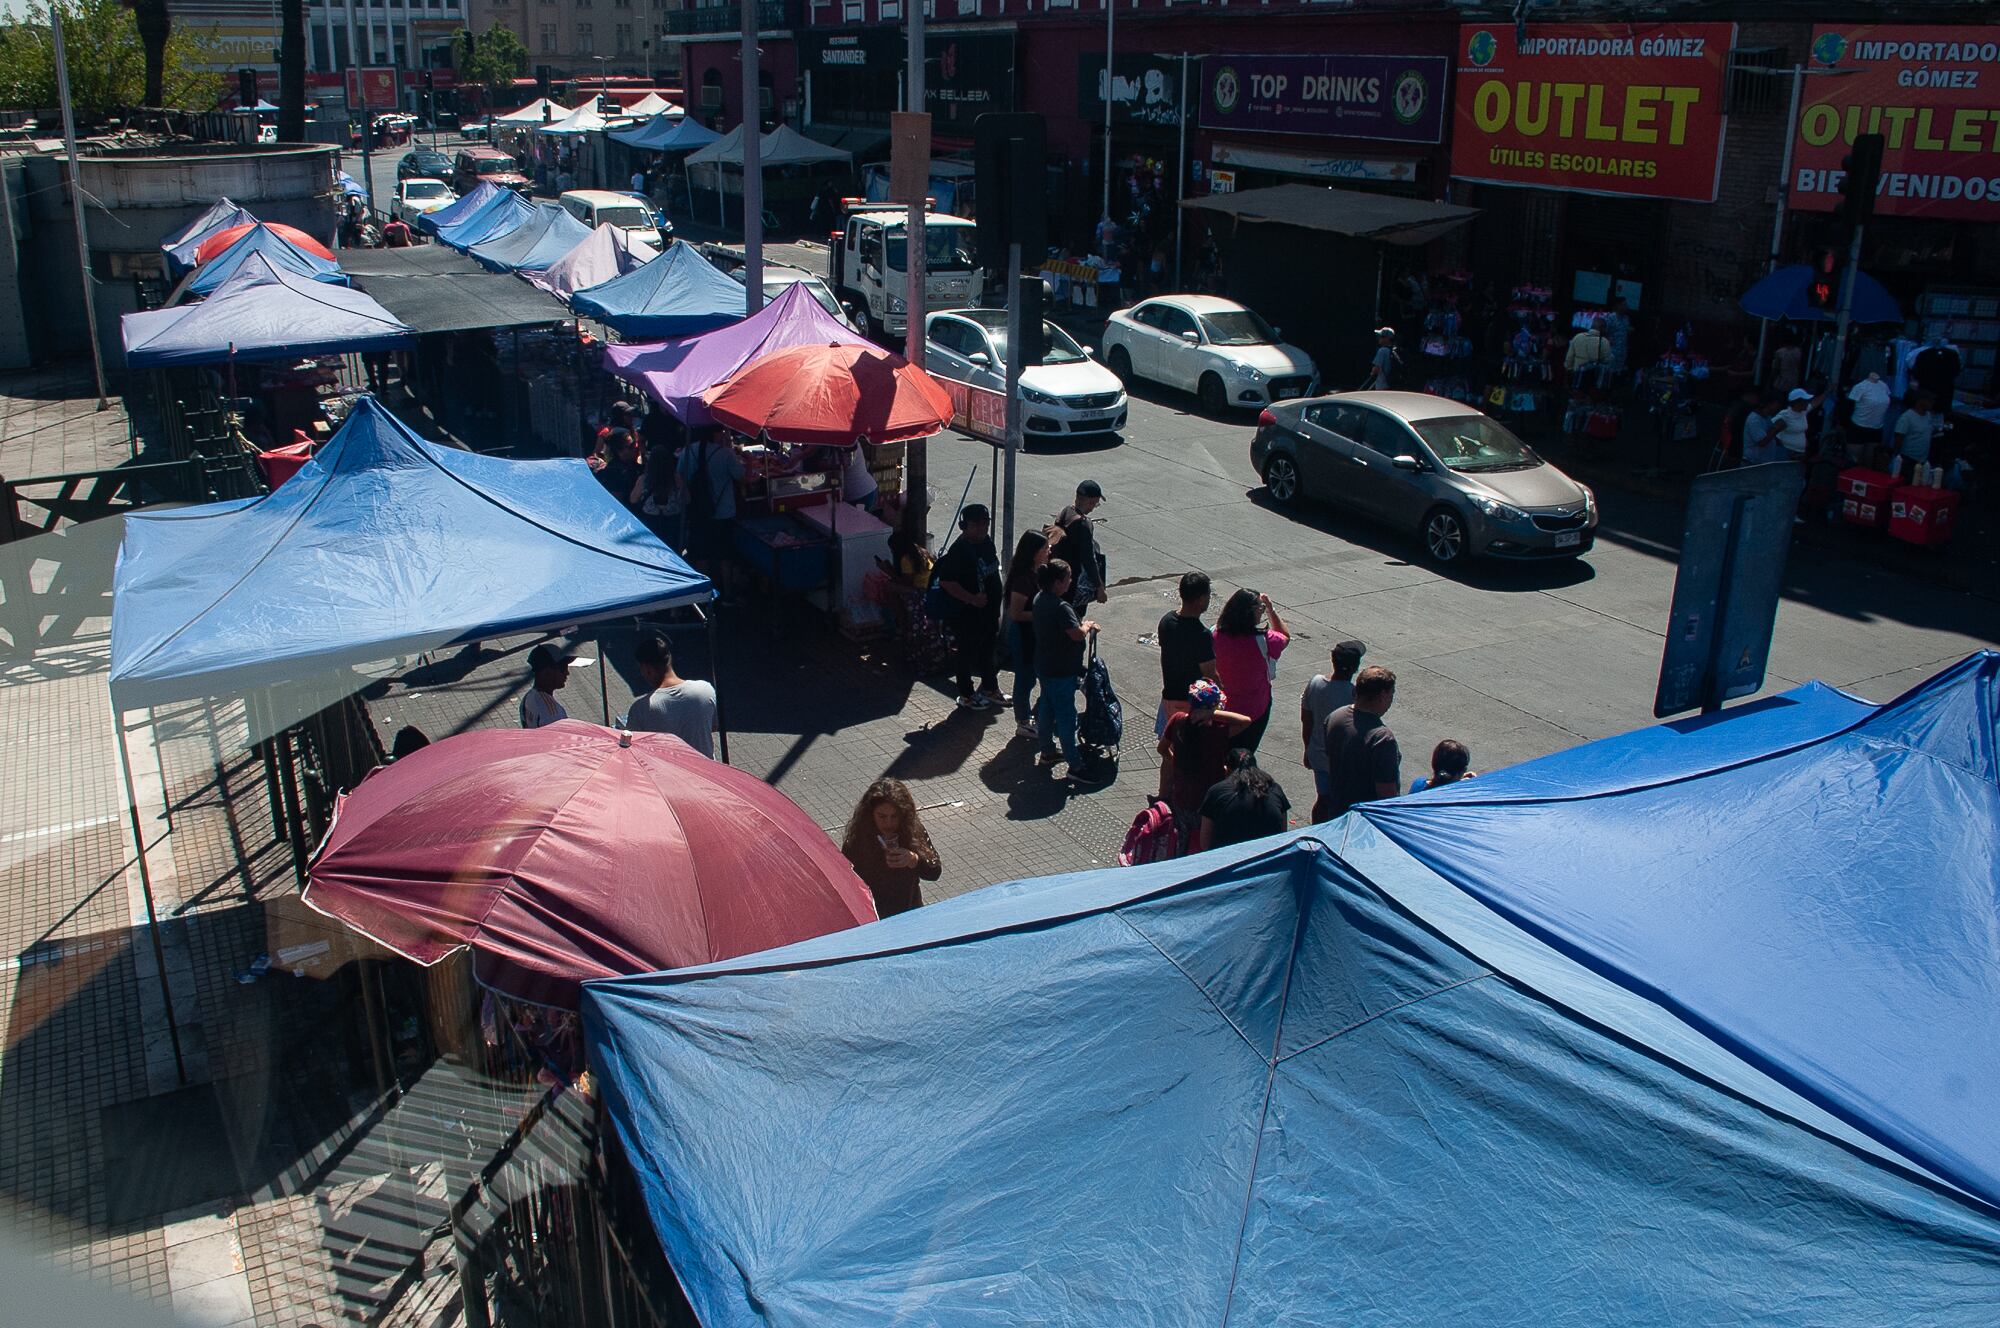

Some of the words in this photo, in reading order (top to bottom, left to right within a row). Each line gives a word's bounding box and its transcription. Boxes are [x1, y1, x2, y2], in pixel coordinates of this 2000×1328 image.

[822, 50, 866, 65] SANTANDER
[1640, 34, 1705, 57] GÓMEZ
[1854, 41, 2000, 62] IMPORTADO
[1250, 74, 1288, 99] TOP
[1302, 76, 1381, 103] DRINKS
[1897, 65, 1980, 88] GÓMEZ
[1473, 80, 1701, 146] OUTLET
[1489, 145, 1545, 168] ÚTILES
[1550, 153, 1657, 179] ESCOLARES
[1797, 168, 2000, 202] BIEVENIDOS
